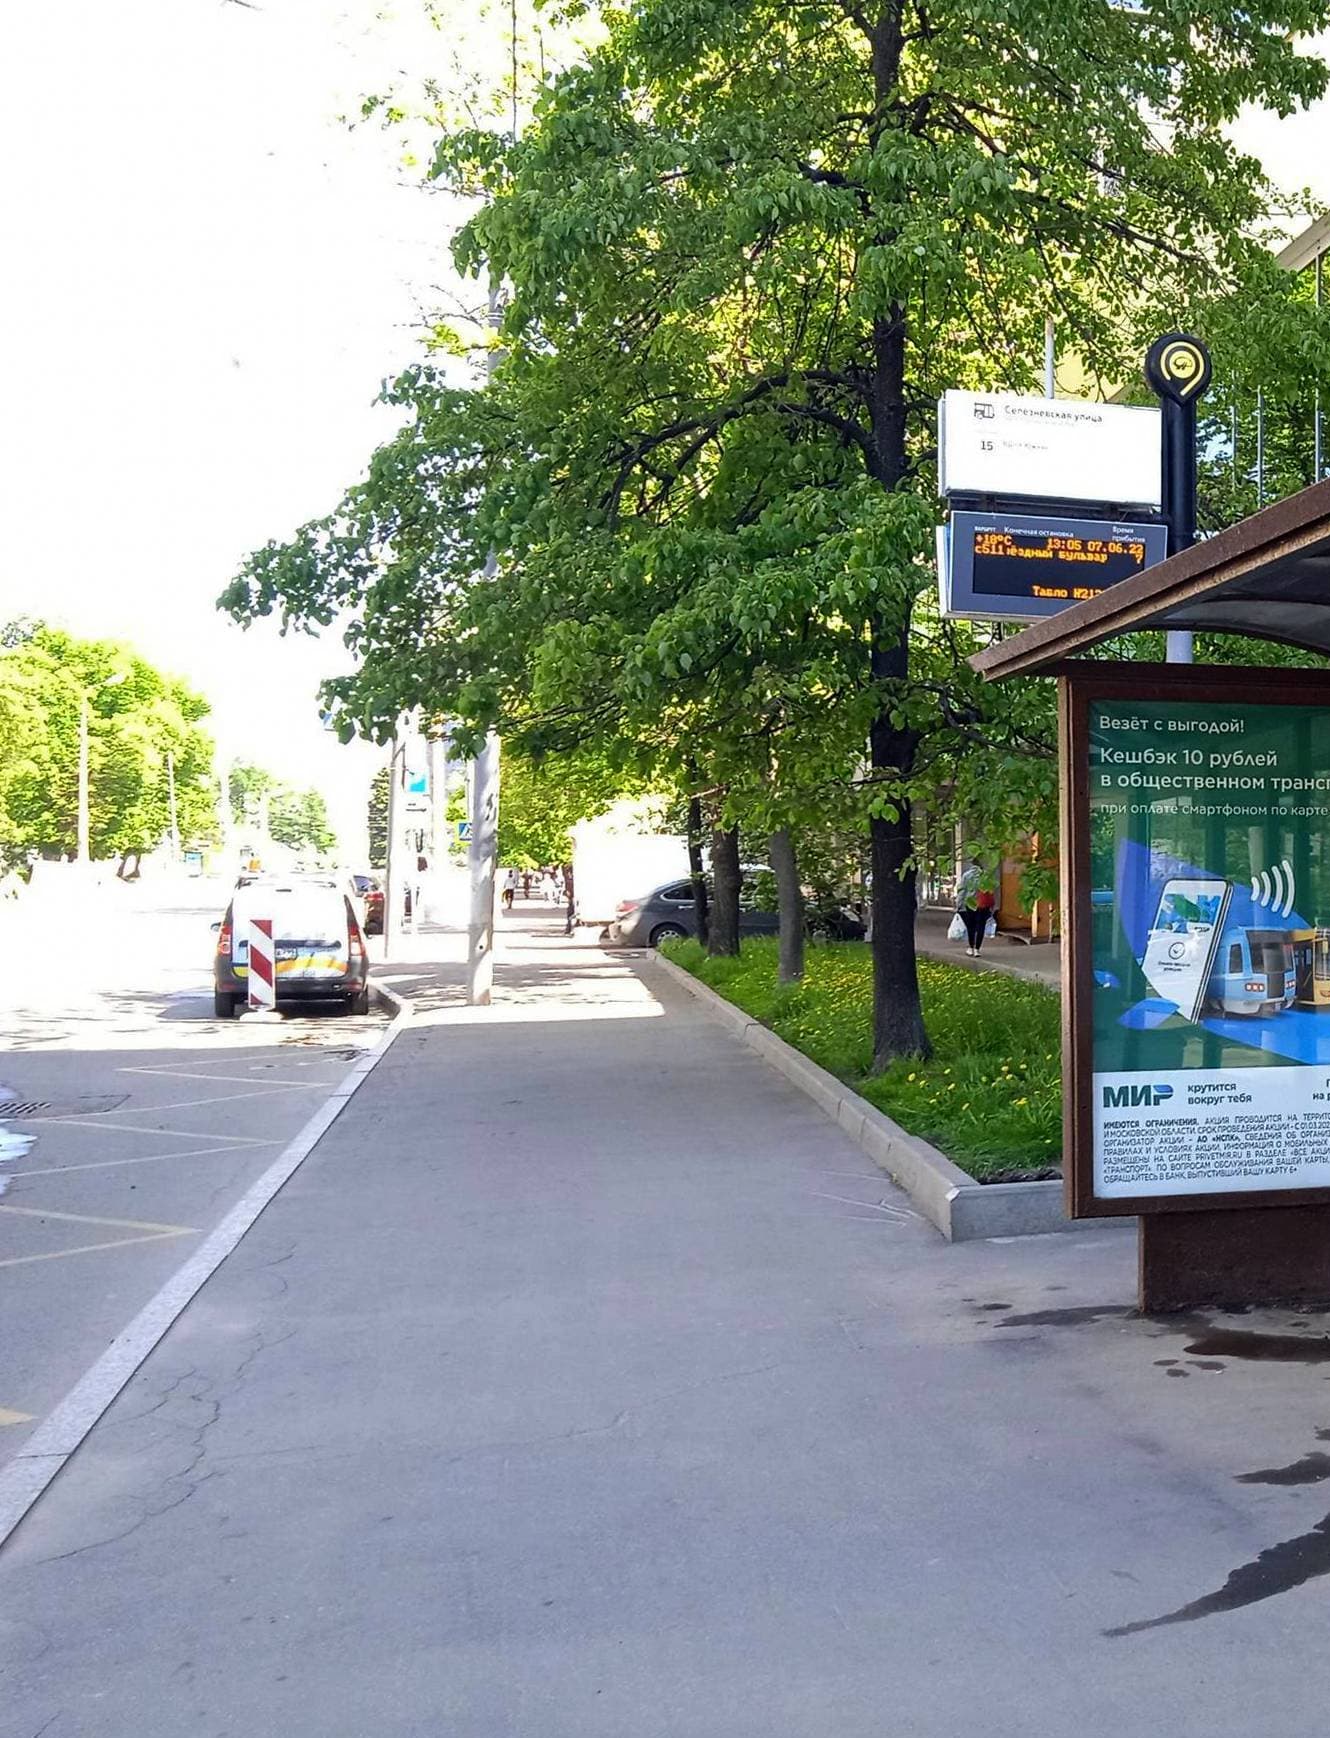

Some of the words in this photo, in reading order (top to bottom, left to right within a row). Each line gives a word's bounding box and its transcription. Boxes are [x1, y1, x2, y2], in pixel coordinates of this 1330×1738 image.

[980, 441, 994, 451] 15
[1047, 538, 1082, 550] 13:05
[1087, 540, 1144, 554] 07.06.22
[1100, 715, 1149, 730] Везёт
[1154, 720, 1163, 731] с
[1168, 718, 1244, 734] выгодой!
[1100, 747, 1177, 764] Кешбэк
[1182, 749, 1203, 765] 10
[1210, 750, 1278, 768] рублей
[1101, 774, 1111, 786] в
[1117, 772, 1265, 790] общественном
[1101, 804, 1127, 815] при
[1131, 804, 1179, 815] оплате
[1182, 803, 1268, 817] смартфоном
[1271, 806, 1288, 816] по
[1291, 806, 1329, 818] карте
[1103, 1084, 1174, 1108] МИР
[1187, 1083, 1237, 1094] крутится
[1312, 1092, 1325, 1100] на
[1188, 1095, 1225, 1106] вокруг
[1227, 1092, 1252, 1103] тебя
[1103, 1120, 1140, 1129] ИМЕЮТСЯ
[1204, 1116, 1229, 1125] АКЦИЯ
[1234, 1114, 1282, 1124] ПРОВОДИТСЯ
[1110, 1128, 1159, 1138] МОСКОВСКОЙ
[1197, 1126, 1217, 1134] СРОК
[1217, 1123, 1266, 1134] ПРОВЕДЕНИЯ
[1266, 1123, 1290, 1132] АКЦИИ
[1103, 1138, 1155, 1147] ОРГАНИЗАТОР
[1159, 1136, 1185, 1145] АКЦИИ
[1197, 1135, 1208, 1143] АО
[1244, 1132, 1282, 1141] СВЕДЕНИЯ
[1286, 1131, 1297, 1139] ОБ
[1103, 1147, 1143, 1156] ПРАВИЛАХ
[1154, 1144, 1192, 1154] УСЛОВИЯХ
[1223, 1140, 1274, 1151] ИНФОРМАЦИЯ
[1276, 1140, 1282, 1148] О
[1284, 1138, 1327, 1148] МОБИЛЬНЫХ
[1103, 1156, 1149, 1165] РАЗМЕЩЕНЫ
[1168, 1153, 1191, 1162] САЙТЕ
[1246, 1150, 1252, 1158] В
[1255, 1149, 1286, 1158] РАЗДЕЛЕ
[1156, 1163, 1167, 1171] ПО
[1170, 1161, 1211, 1171] ВОПРОСАМ
[1214, 1158, 1273, 1169] ОБСЛУЖИВАНИЯ
[1276, 1156, 1302, 1165] ВАШЕЙ
[1103, 1174, 1159, 1183] ОБРАЩАЙТЕСЬ
[1187, 1169, 1243, 1179] ВЫПУСТИВШИЙ
[1243, 1167, 1264, 1176] ВАШУ
